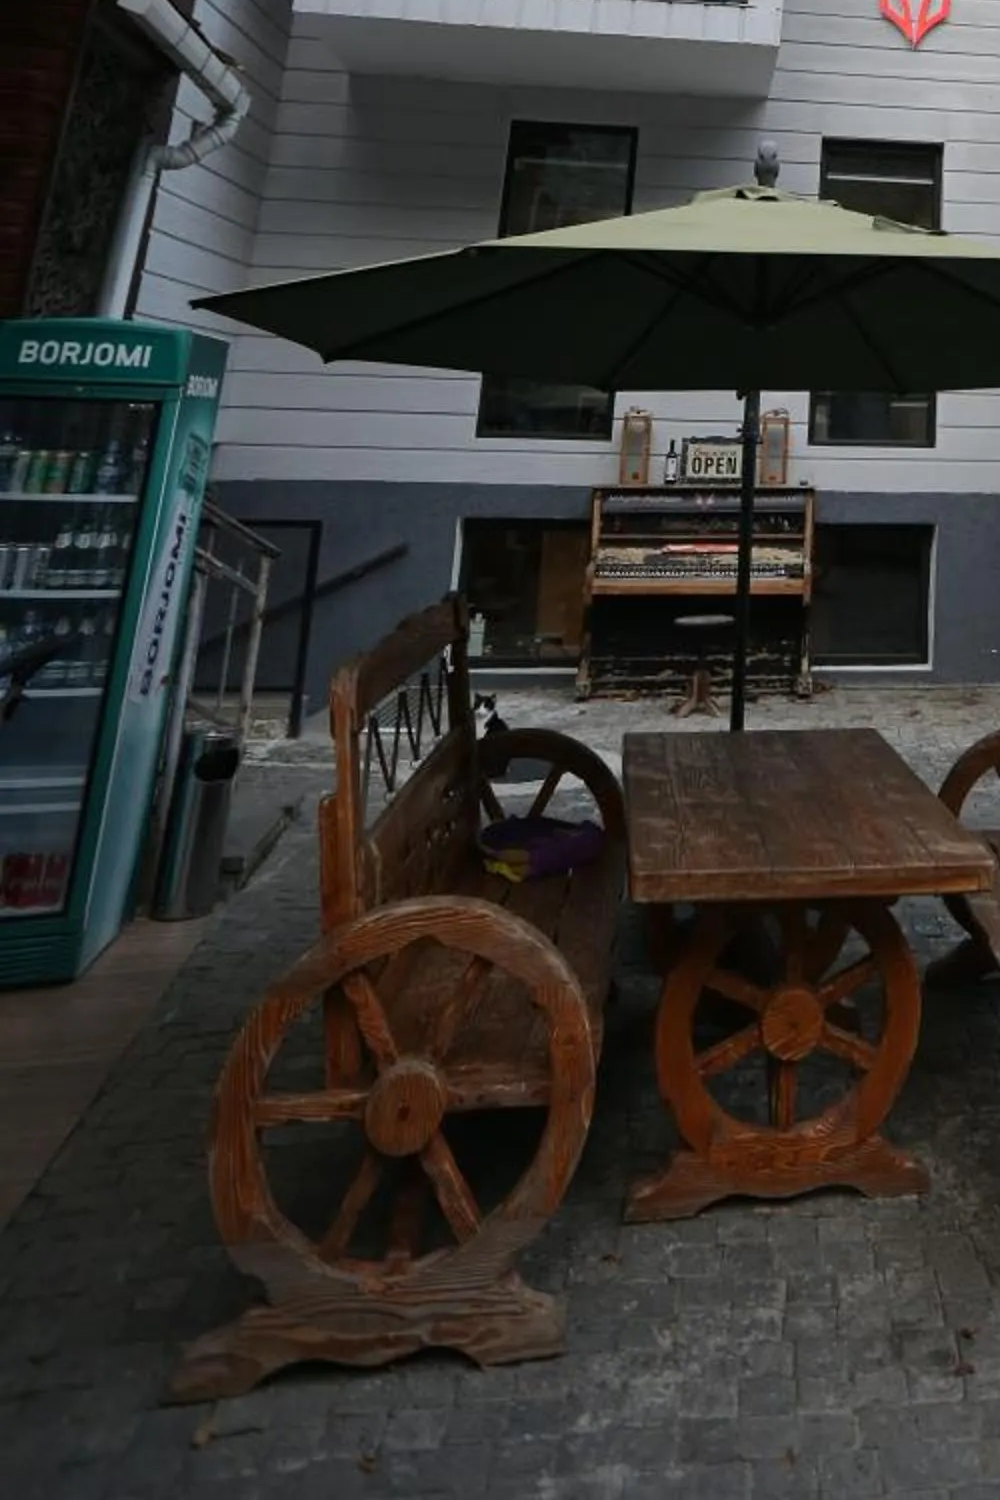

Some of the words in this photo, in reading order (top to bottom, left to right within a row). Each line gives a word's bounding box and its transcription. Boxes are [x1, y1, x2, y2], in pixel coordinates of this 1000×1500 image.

[18, 340, 152, 368] BORJOMI
[691, 457, 737, 475] OPEN
[140, 513, 187, 696] BORJOMI
